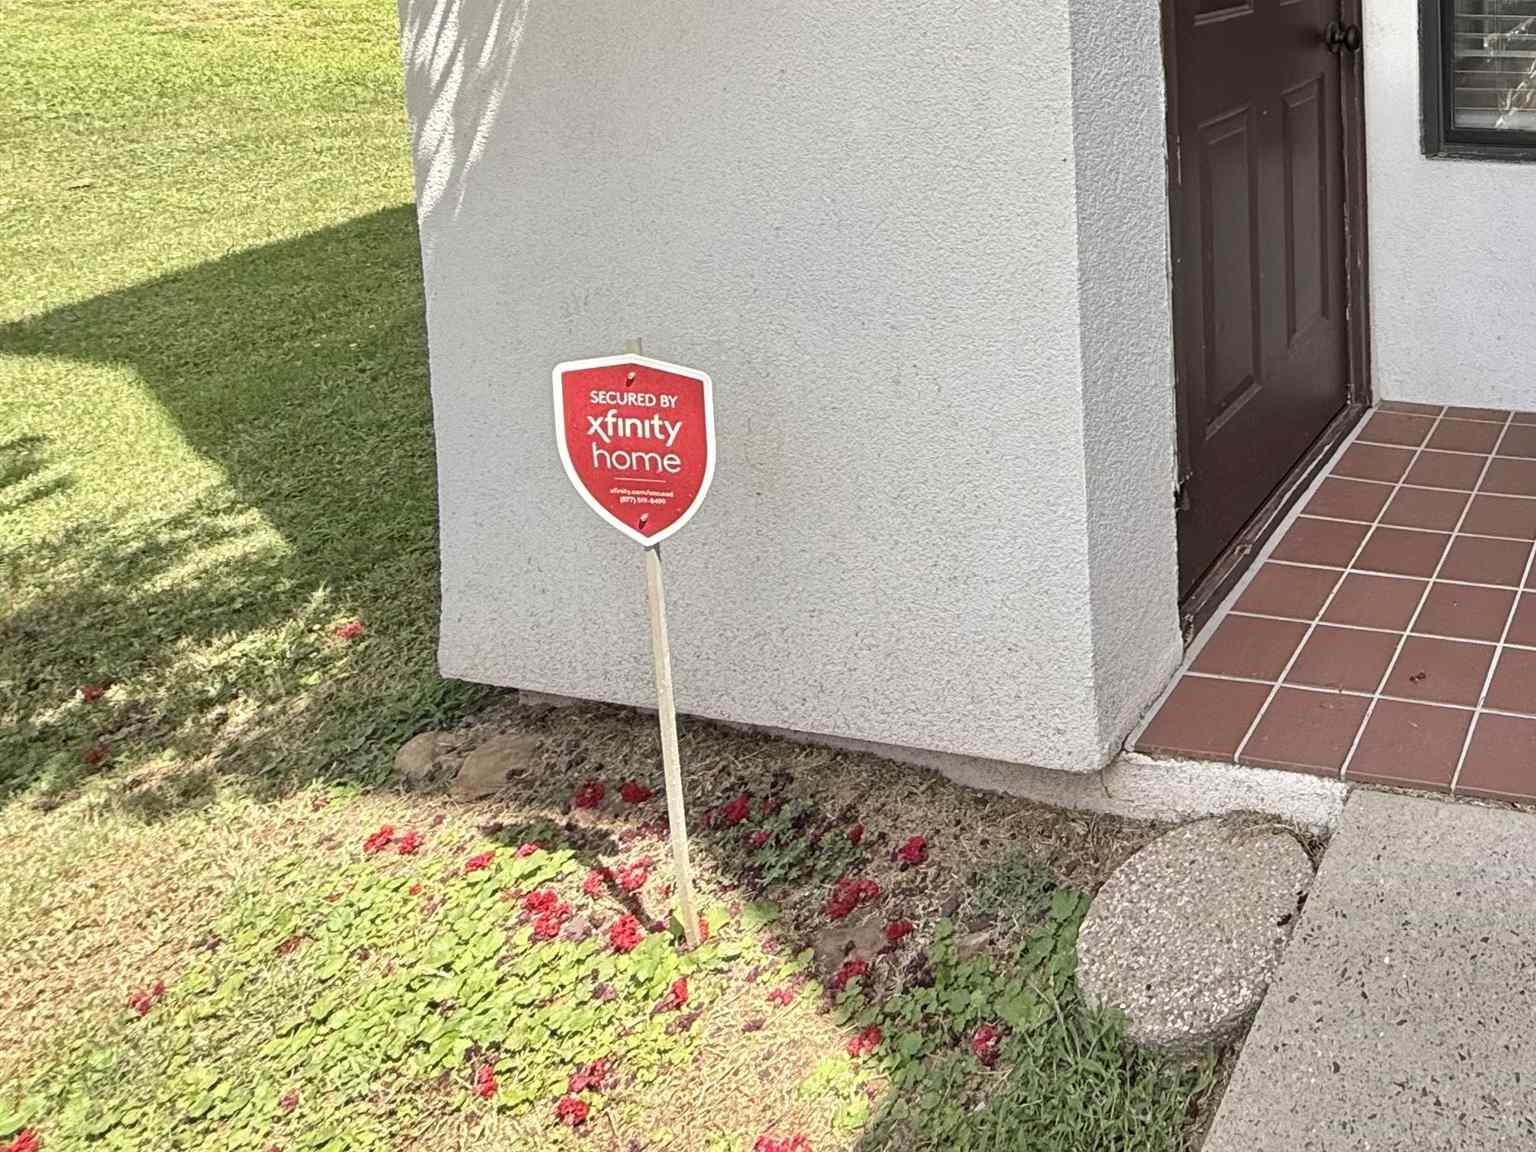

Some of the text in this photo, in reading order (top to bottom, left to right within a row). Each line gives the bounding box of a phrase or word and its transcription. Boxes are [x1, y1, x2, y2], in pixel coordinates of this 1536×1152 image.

[589, 390, 678, 408] SECURED BY
[587, 409, 682, 447] xfinity
[592, 442, 681, 473] home
